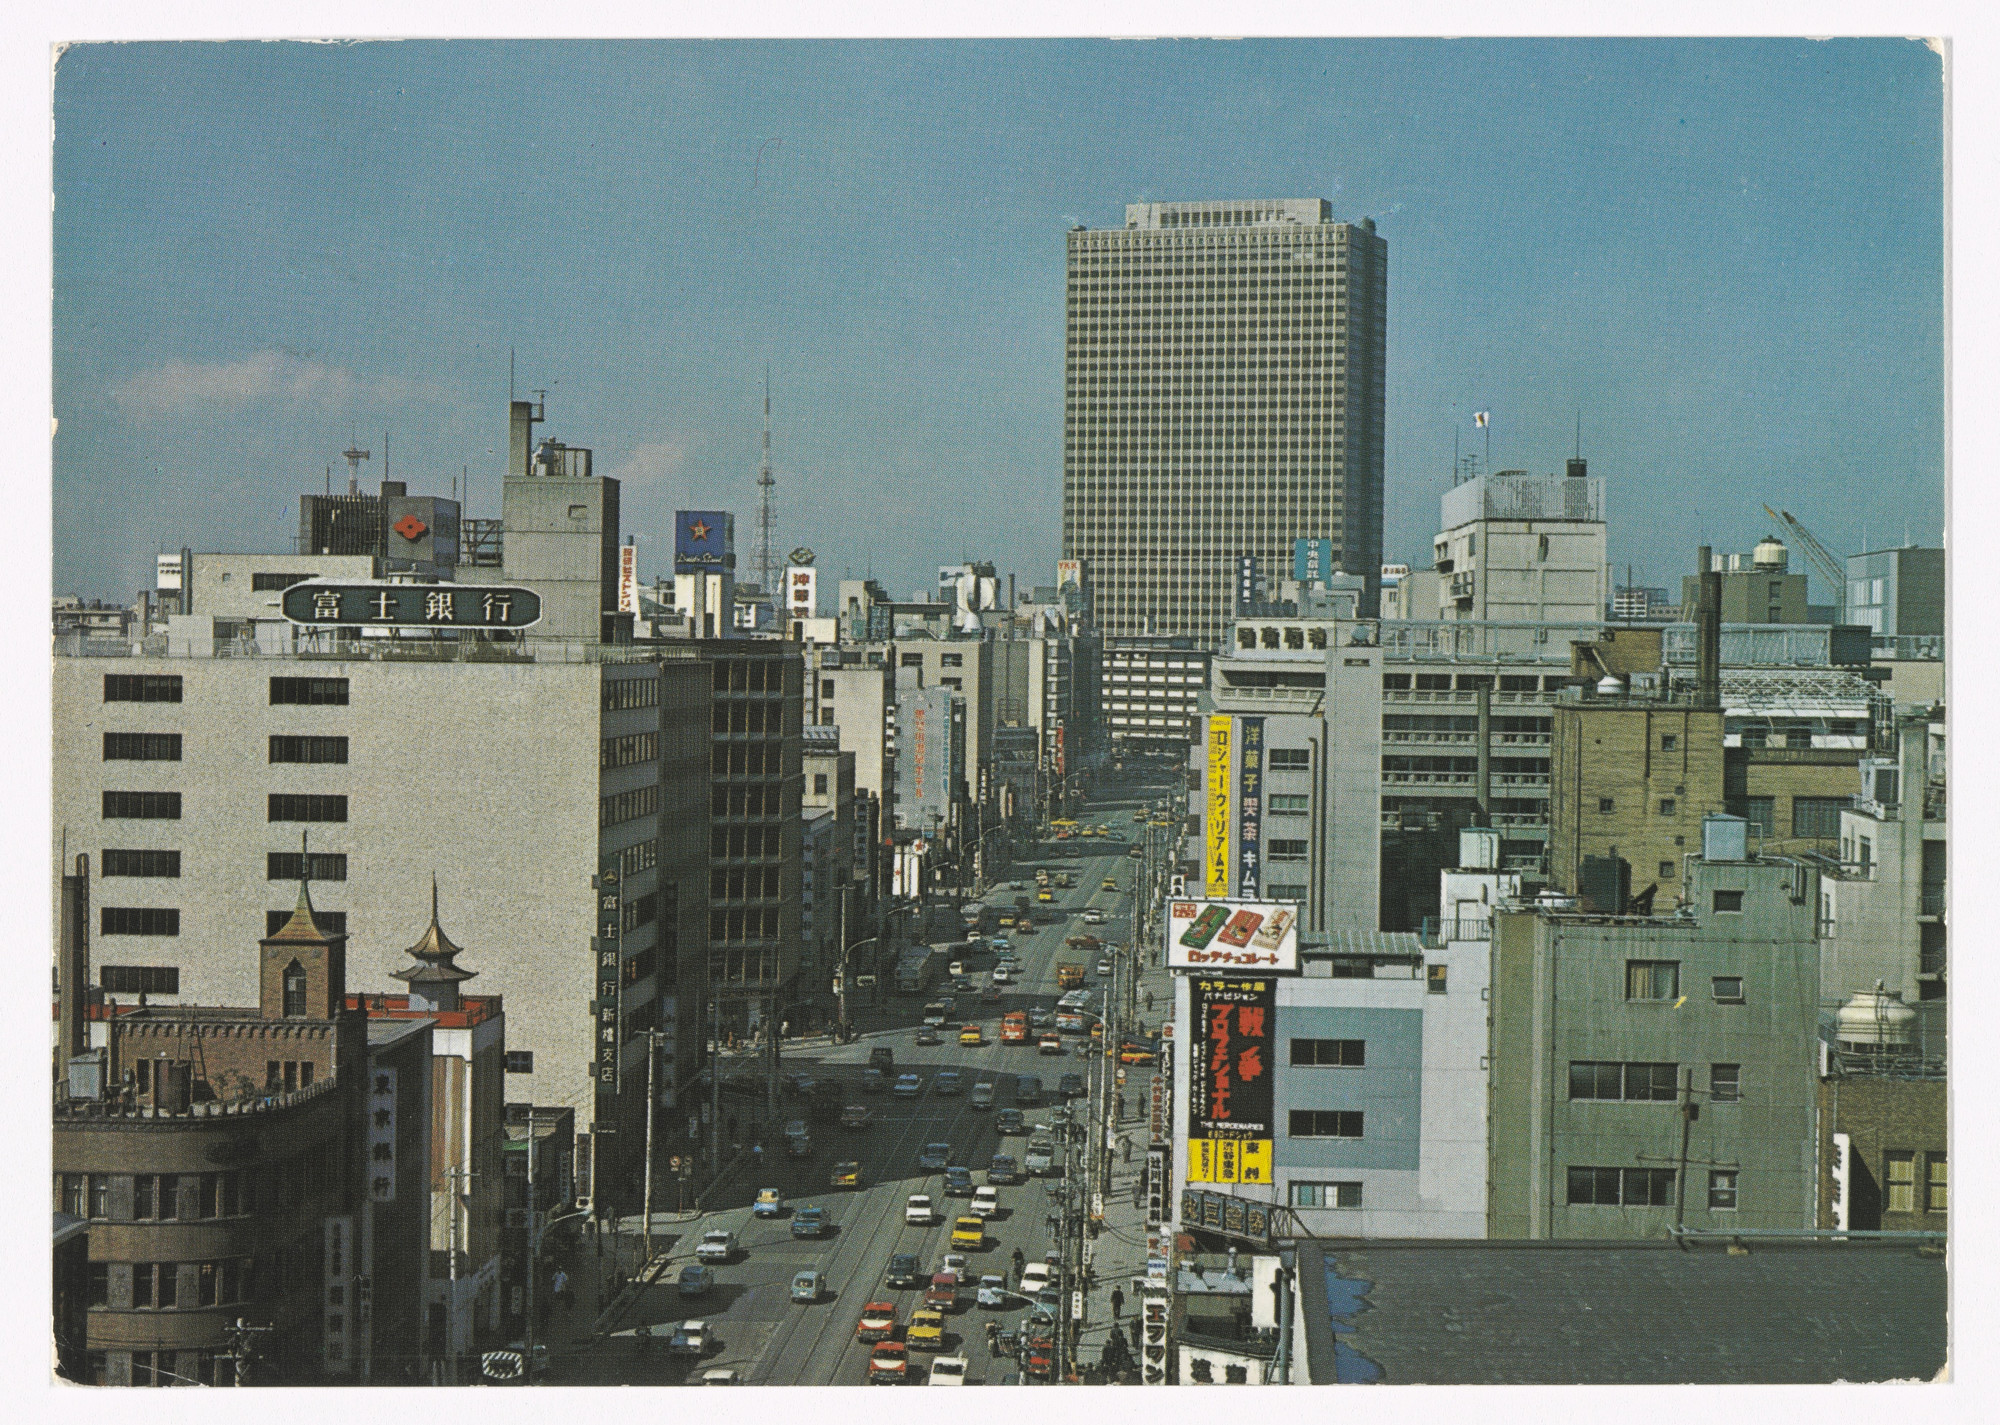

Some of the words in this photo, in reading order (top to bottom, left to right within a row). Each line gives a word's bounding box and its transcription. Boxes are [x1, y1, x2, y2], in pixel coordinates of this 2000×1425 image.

[312, 591, 512, 622] 富士銀行
[1187, 949, 1280, 965] ロッテチョコレート
[1199, 981, 1266, 992] カラー作品
